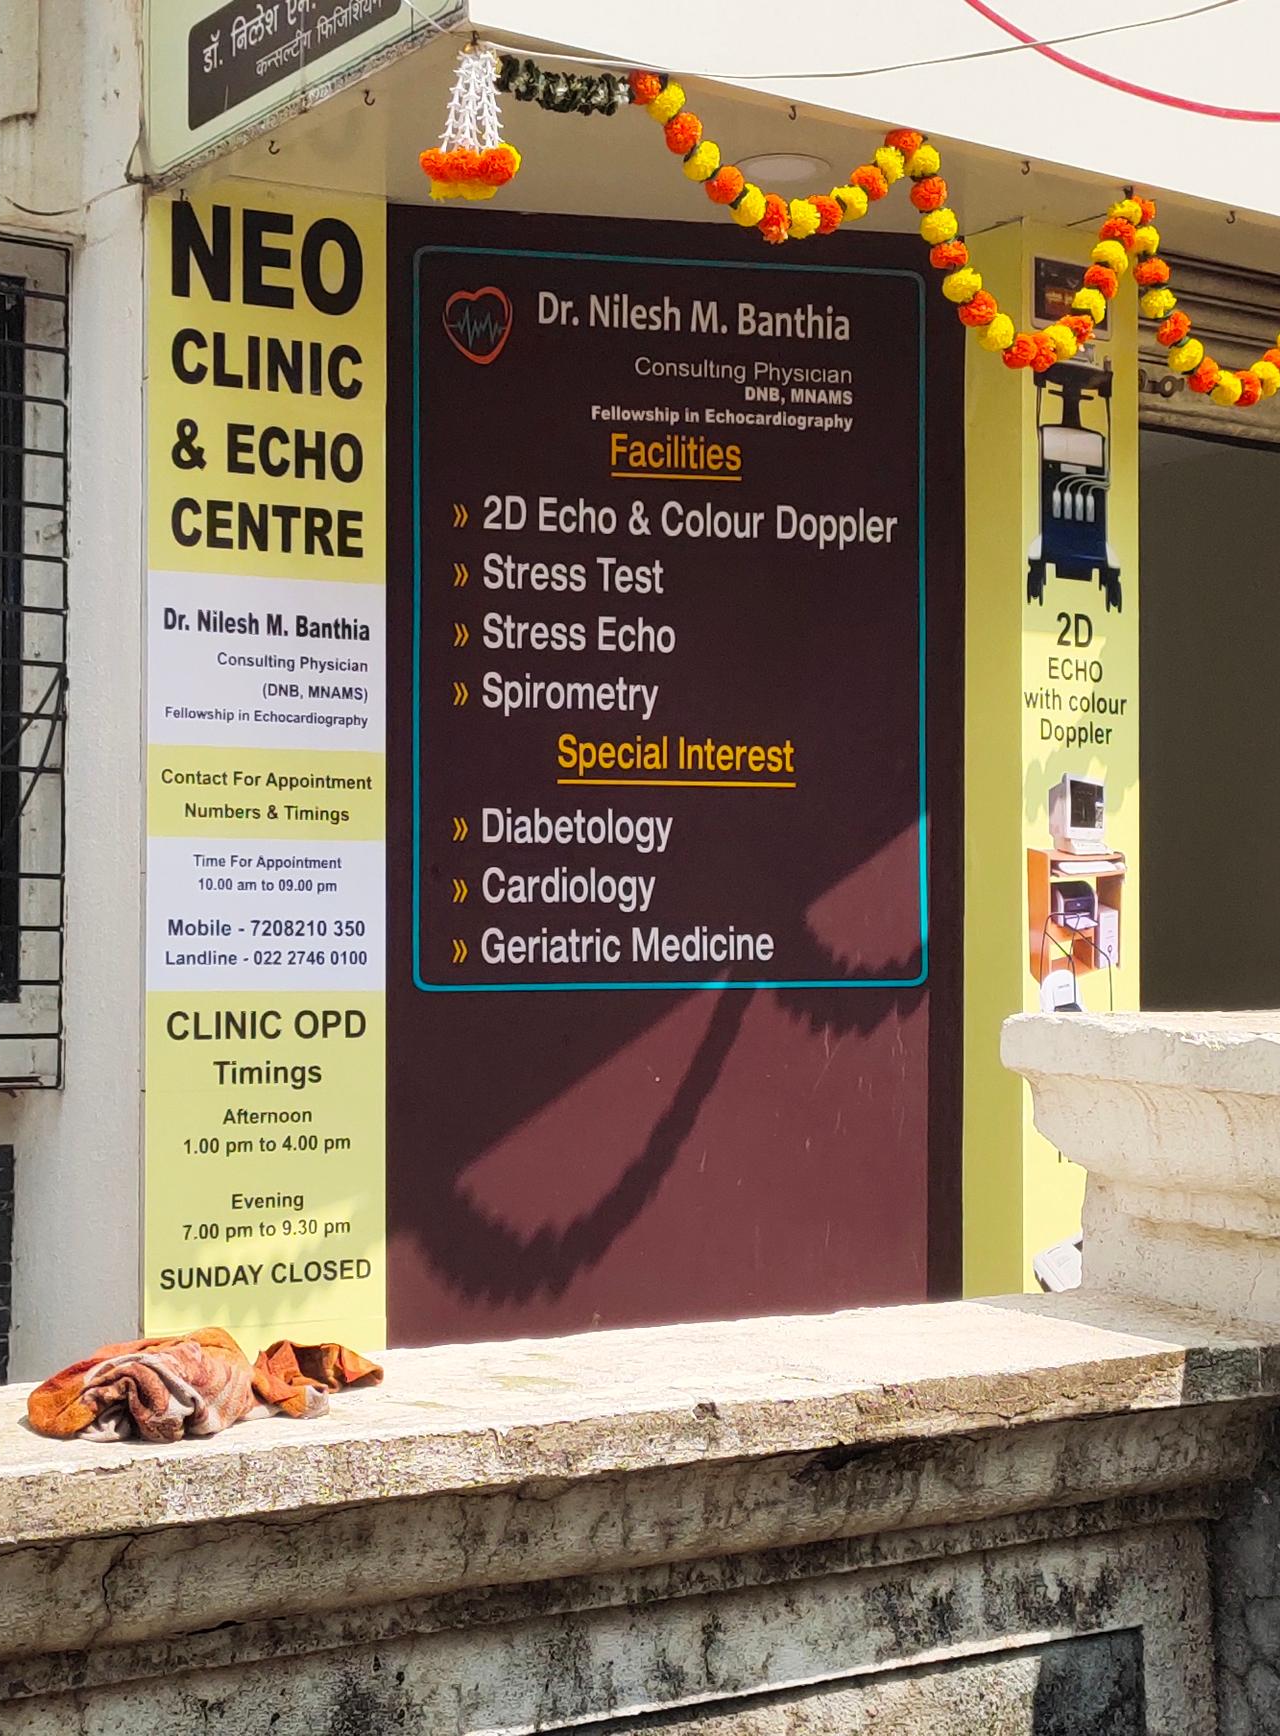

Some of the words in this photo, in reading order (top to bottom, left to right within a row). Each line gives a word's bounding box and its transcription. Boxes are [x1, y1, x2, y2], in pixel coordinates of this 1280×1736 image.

[203, 30, 223, 73] डॉ.
[231, 2, 279, 57] निलेश
[171, 201, 363, 316] NEO
[538, 291, 579, 326] Dr.
[589, 294, 681, 332] Nilesh
[690, 300, 727, 335] M.
[738, 303, 851, 341] Banthia
[171, 328, 363, 400] CLINIC
[634, 356, 746, 384] Consulting
[754, 362, 852, 386] Physician
[744, 385, 786, 405] DNB,
[791, 389, 853, 405] MNAMS
[591, 405, 680, 426] Fellowship
[684, 408, 700, 423] in
[705, 409, 853, 432] Echocardiography
[171, 418, 207, 471] &
[227, 422, 363, 484] ECHO
[610, 432, 743, 471] Facilities
[171, 497, 363, 558] CENTRE
[482, 495, 527, 531] 2D
[538, 497, 618, 536] Echo
[628, 500, 651, 536] &
[660, 501, 765, 538] Colour
[776, 505, 899, 550] Doppler
[482, 553, 586, 592] Stress
[597, 556, 664, 594] Test
[164, 607, 190, 631] Dr.
[197, 609, 259, 635] Nilesh
[267, 613, 288, 637] M.
[296, 616, 370, 641] Banthia
[482, 613, 586, 651] Stress
[597, 616, 677, 654] Echo
[1057, 612, 1093, 648] 2D
[217, 652, 295, 672] Consulting
[300, 656, 368, 673] Physician
[1048, 657, 1103, 683] ECHO
[262, 683, 304, 700] (DNB,
[308, 685, 368, 704] MNAMS)
[481, 672, 659, 721] Spirometry
[1024, 688, 1062, 710] with
[1069, 691, 1127, 715] colour
[165, 707, 235, 723] Fellowship
[238, 709, 250, 721] in
[254, 710, 368, 728] Echocardiography
[1040, 718, 1112, 748] Doppler
[557, 733, 668, 776] Special
[678, 735, 795, 773] Interest
[161, 769, 228, 785] Contact
[233, 771, 261, 787] For
[266, 772, 372, 791] Appointment
[185, 803, 261, 819] Numbers
[267, 804, 279, 820] &
[284, 805, 350, 825] Timings
[481, 808, 673, 854] Diabetology
[193, 854, 226, 867] Time
[231, 855, 253, 868] For
[256, 856, 342, 871] Appointment
[199, 878, 233, 891] 10.00
[237, 880, 257, 891] am
[261, 880, 274, 891] to
[279, 880, 313, 892] 09.00
[317, 882, 337, 894] pm
[481, 867, 657, 913] Cardiology
[168, 919, 232, 936] Mobile
[251, 920, 327, 936] 7208210
[334, 920, 365, 936] 350
[165, 951, 238, 966] Landline
[254, 951, 282, 965] 022
[287, 951, 325, 965] 2746
[331, 951, 367, 965] 0100
[481, 927, 620, 965] Geriatric
[631, 926, 775, 963] Medicine
[167, 1010, 282, 1041] CLINIC
[295, 1009, 367, 1039] OPD
[213, 1060, 322, 1089] Timings
[222, 1108, 313, 1125] Afternoon
[184, 1138, 220, 1155] 1.00
[226, 1139, 253, 1156] pm
[260, 1137, 277, 1152] to
[282, 1135, 318, 1151] 4.00
[324, 1135, 351, 1154] pm
[231, 1192, 304, 1211] Evening
[182, 1223, 220, 1241] 7.00
[226, 1224, 253, 1242] pm
[259, 1222, 276, 1237] to
[282, 1219, 318, 1237] 9.30
[324, 1219, 351, 1237] pm
[160, 1263, 264, 1290] SUNDAY
[271, 1258, 371, 1284] CLOSED
